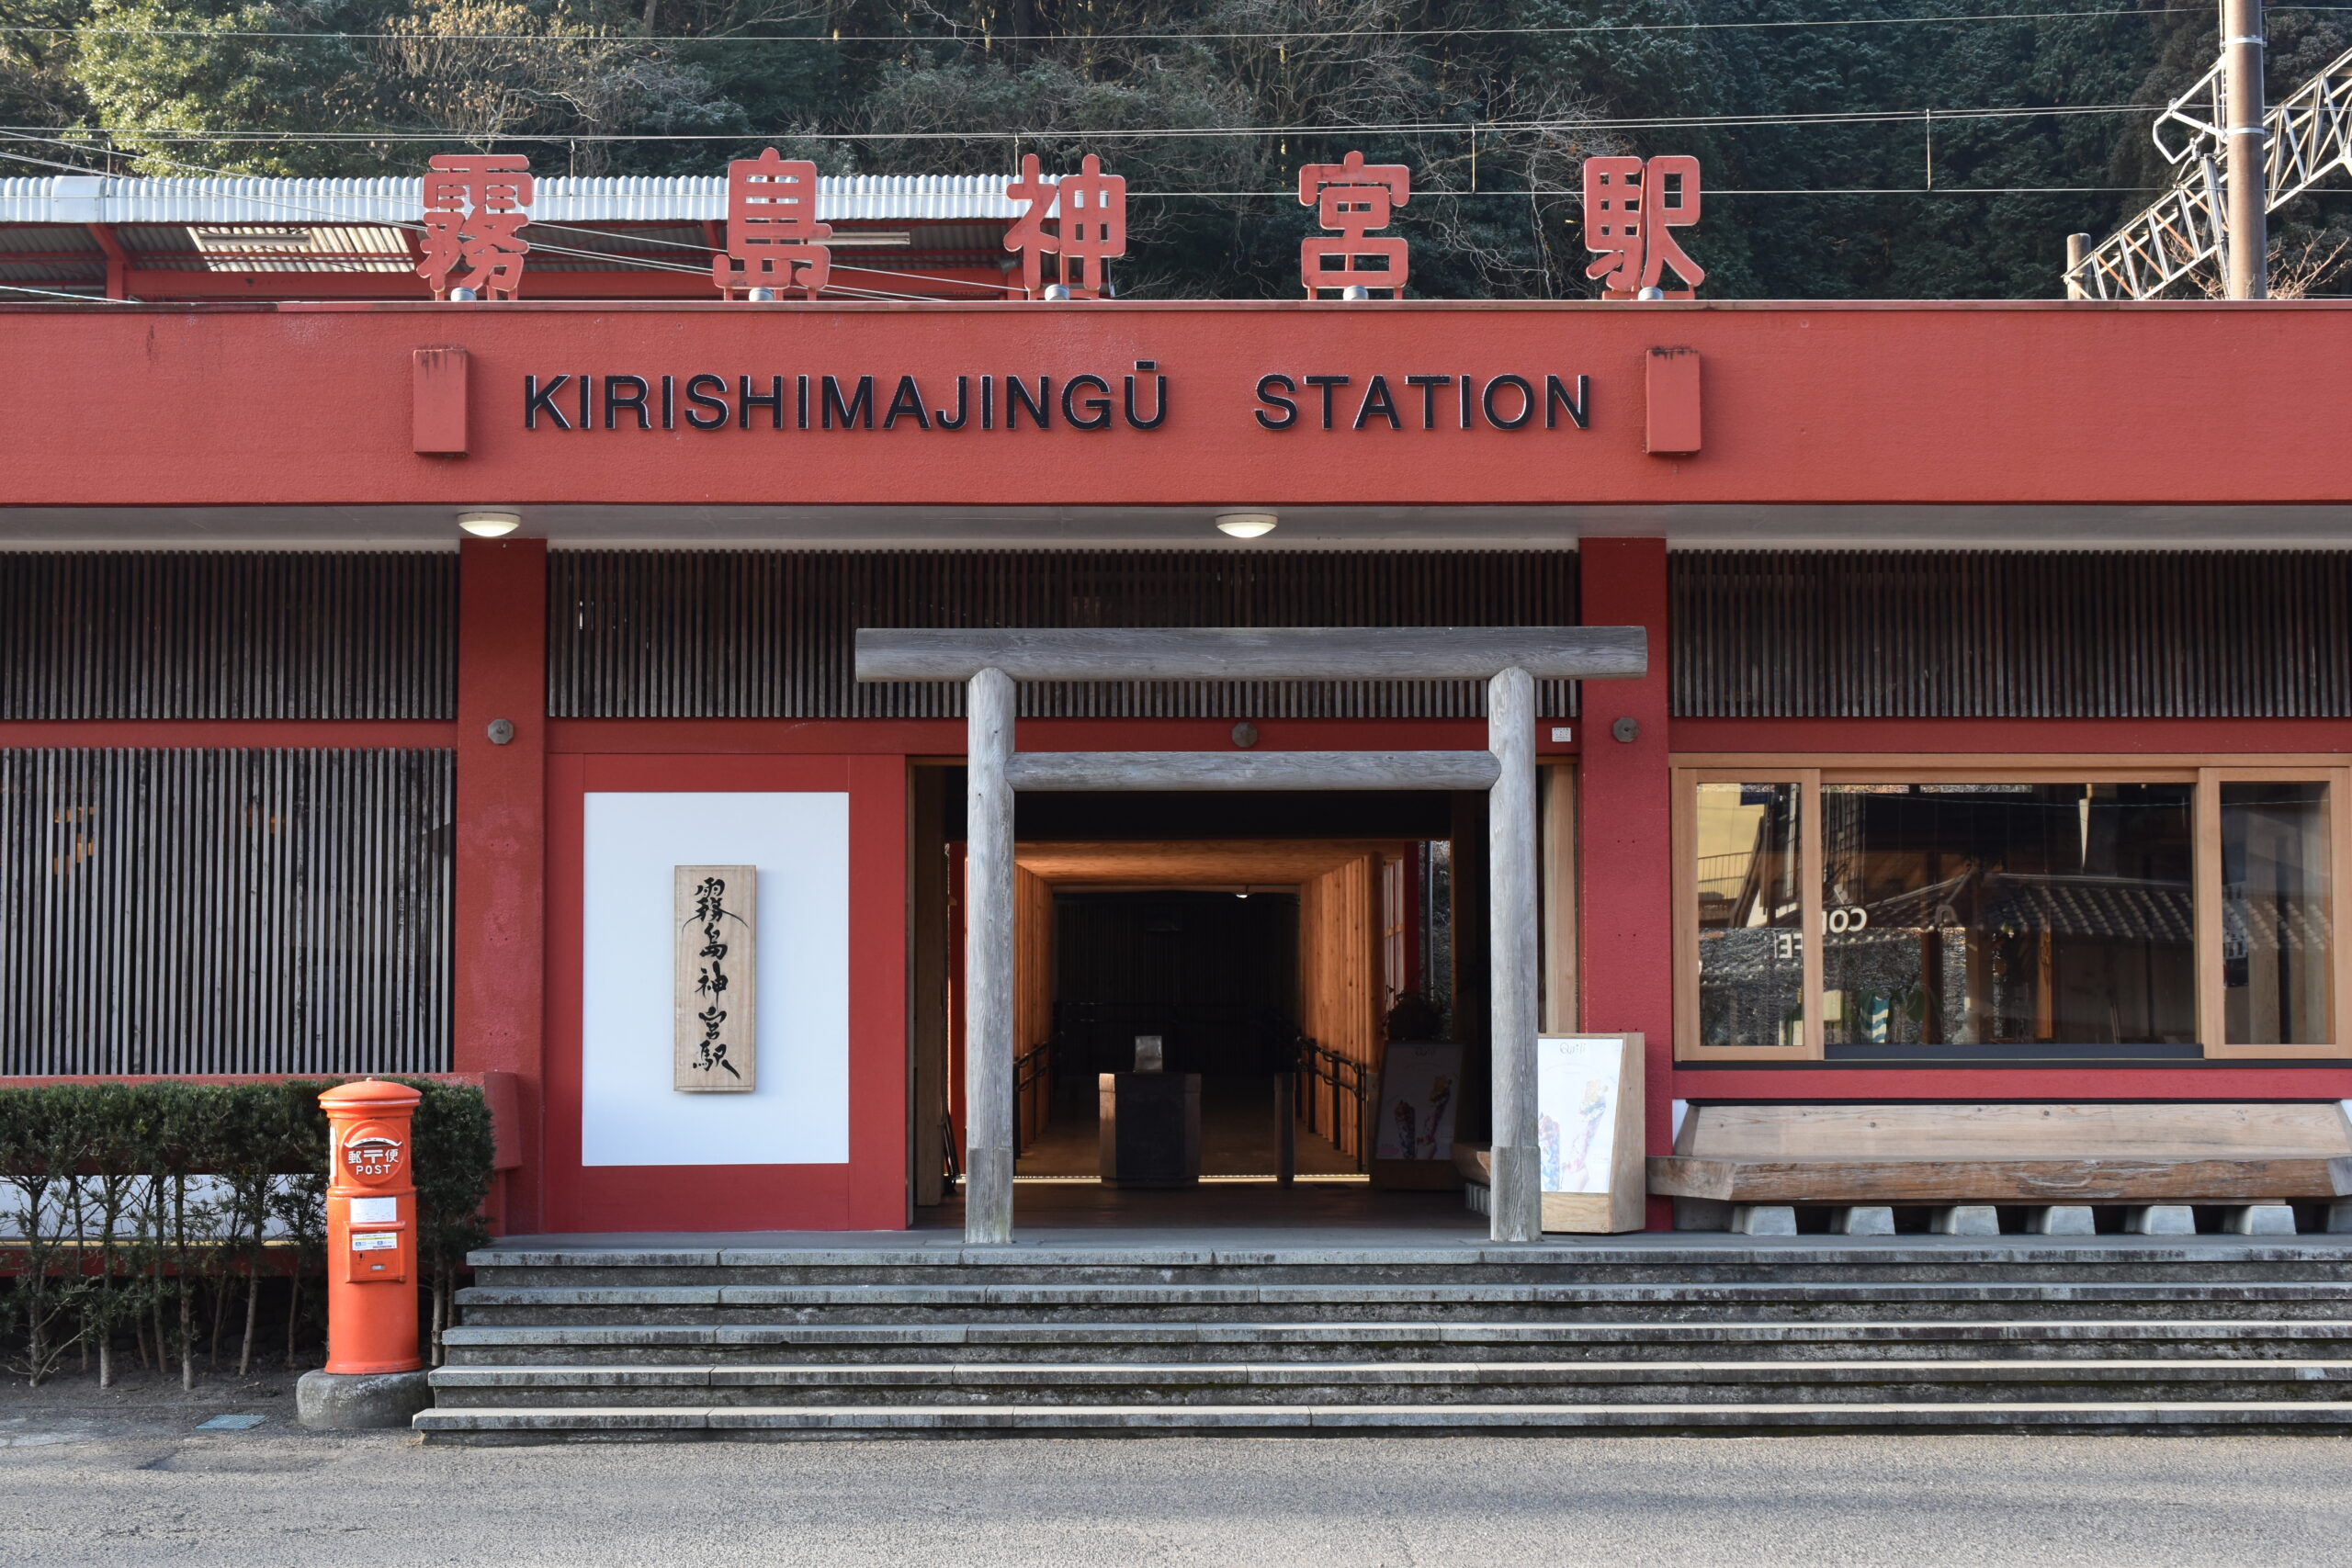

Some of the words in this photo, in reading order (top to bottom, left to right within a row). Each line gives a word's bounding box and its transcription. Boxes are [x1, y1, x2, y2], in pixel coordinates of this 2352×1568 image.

[415, 147, 1705, 292] 霧島神宮駅
[524, 359, 1168, 431] KIRISHIMAJINGŪ
[1253, 373, 1591, 431] STATION
[681, 876, 750, 1080] 霧島神宮駅
[356, 1164, 391, 1176] POST
